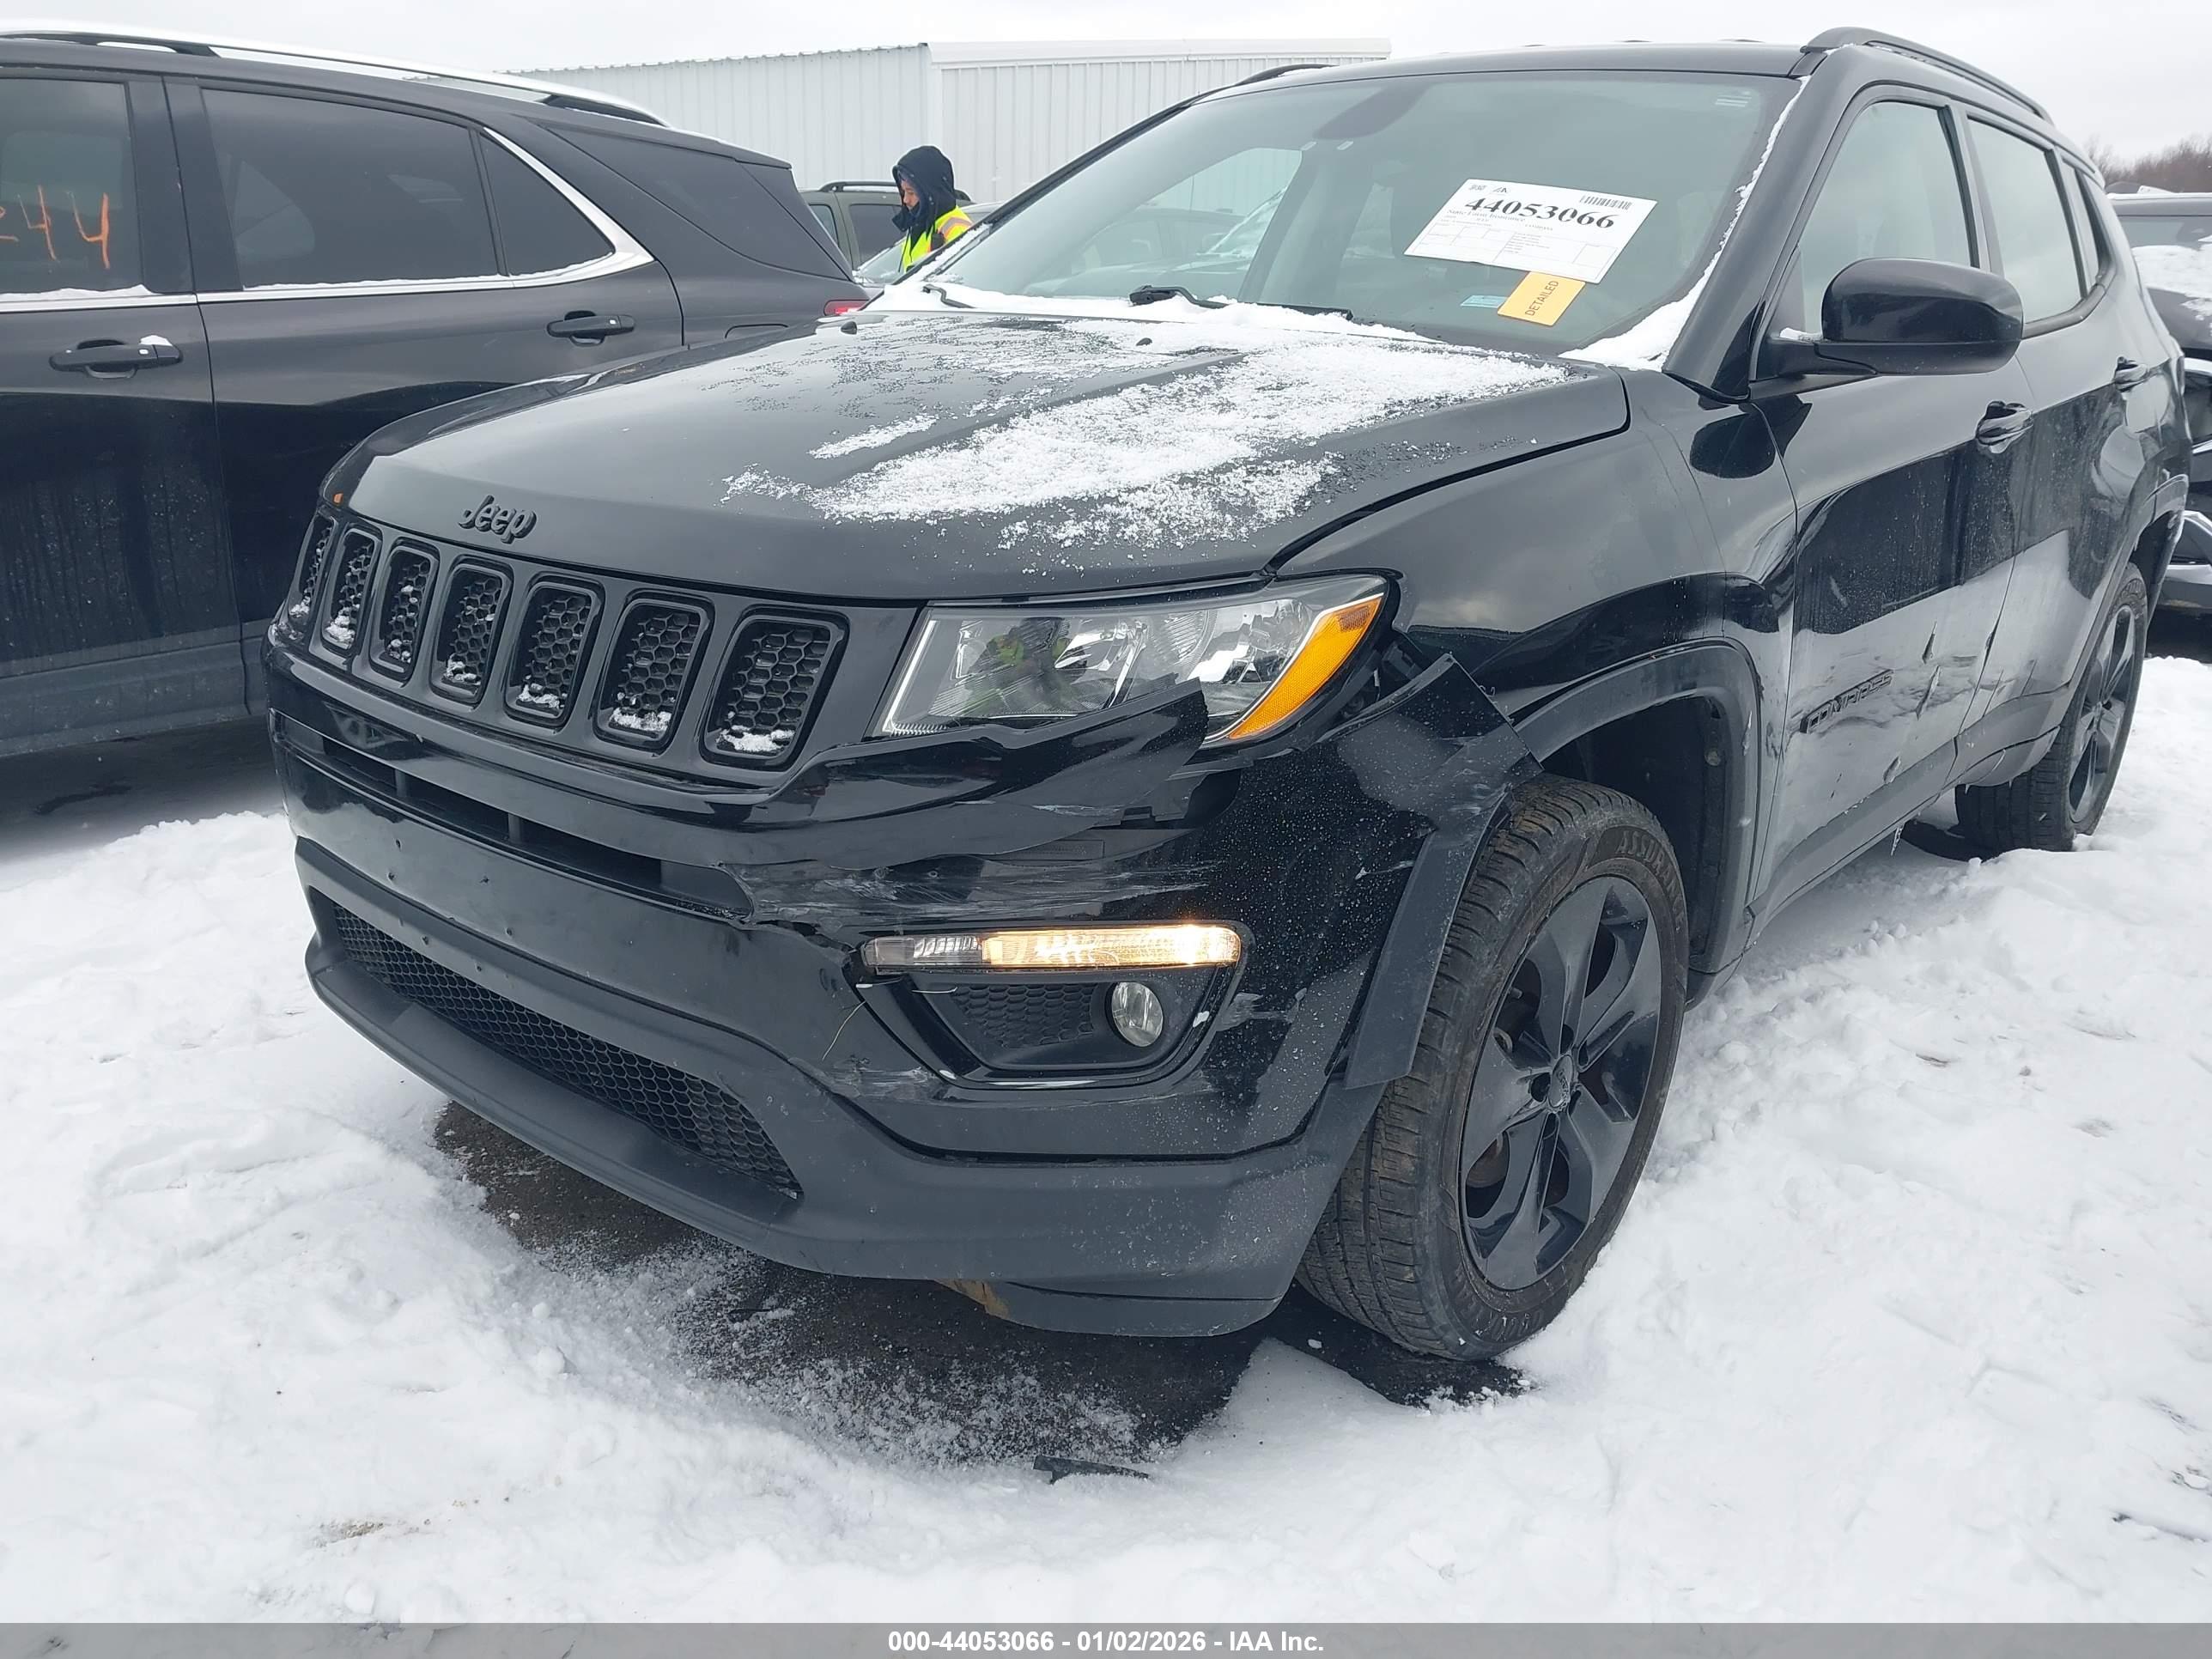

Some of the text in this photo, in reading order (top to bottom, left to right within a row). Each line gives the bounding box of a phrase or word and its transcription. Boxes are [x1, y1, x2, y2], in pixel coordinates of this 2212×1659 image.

[1465, 198, 1620, 228] 44053066
[1524, 280, 1559, 316] DETAILED
[458, 495, 538, 544] Jeep
[1800, 669, 1893, 734] COMPASS
